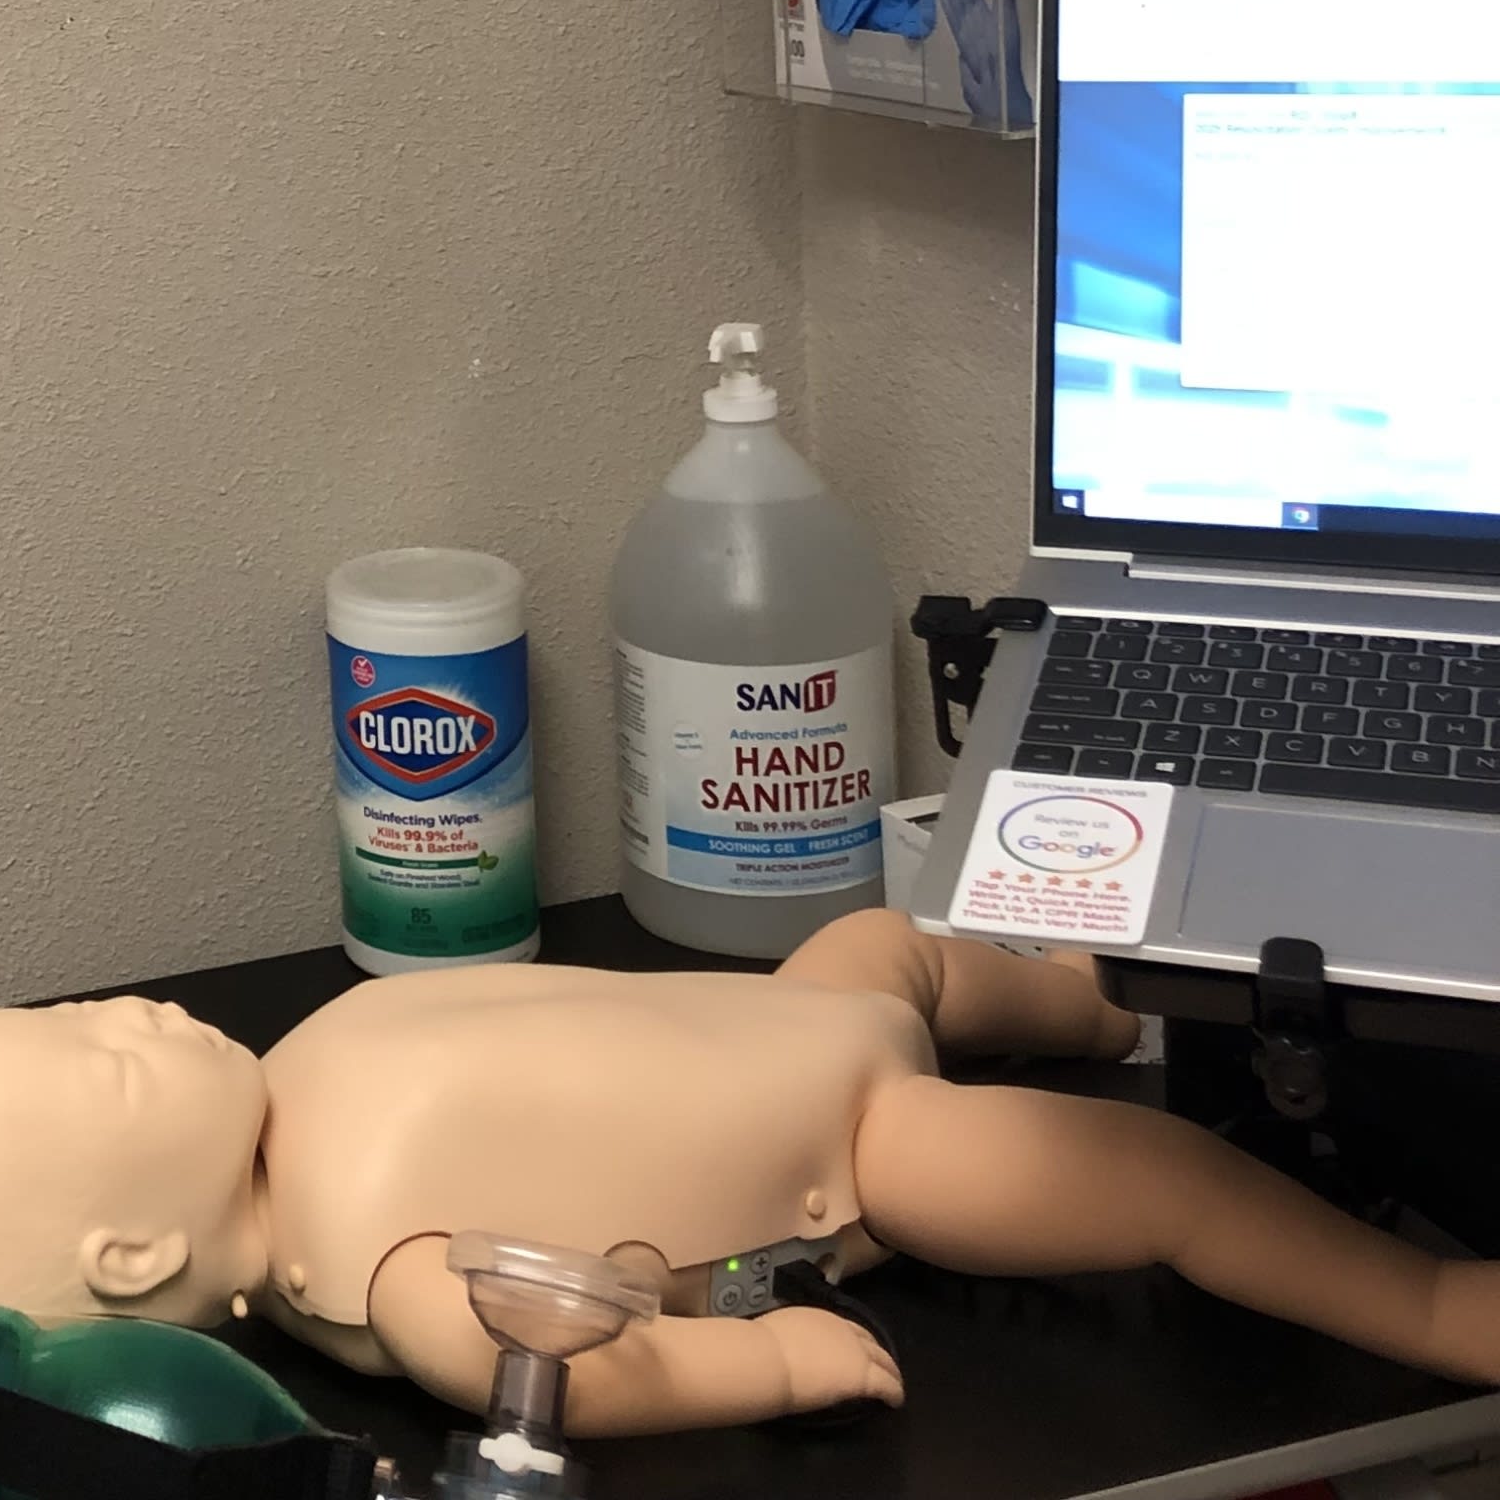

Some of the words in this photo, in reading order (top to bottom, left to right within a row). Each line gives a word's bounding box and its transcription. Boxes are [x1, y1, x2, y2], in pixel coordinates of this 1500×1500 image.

[736, 676, 836, 712] SANIT
[359, 711, 477, 755] CLOROX
[730, 728, 799, 741] Advanced
[802, 722, 848, 739] Formula
[735, 741, 845, 777] HAND
[701, 768, 872, 813] SANITIZER
[363, 806, 436, 828] Disinfecting
[735, 821, 760, 833] Kills
[762, 819, 808, 834] 99.99%
[810, 816, 849, 831] Germs
[1034, 813, 1087, 828] Review
[376, 827, 401, 841] Kills
[403, 829, 448, 842] 99.9%
[450, 829, 465, 841] of
[414, 843, 424, 853] &
[427, 840, 479, 854] Bacteria
[708, 839, 771, 853] SOOTHING
[773, 841, 797, 854] GEL
[808, 837, 840, 851] FRESH
[1018, 834, 1116, 859] Google
[410, 907, 432, 924] 85
